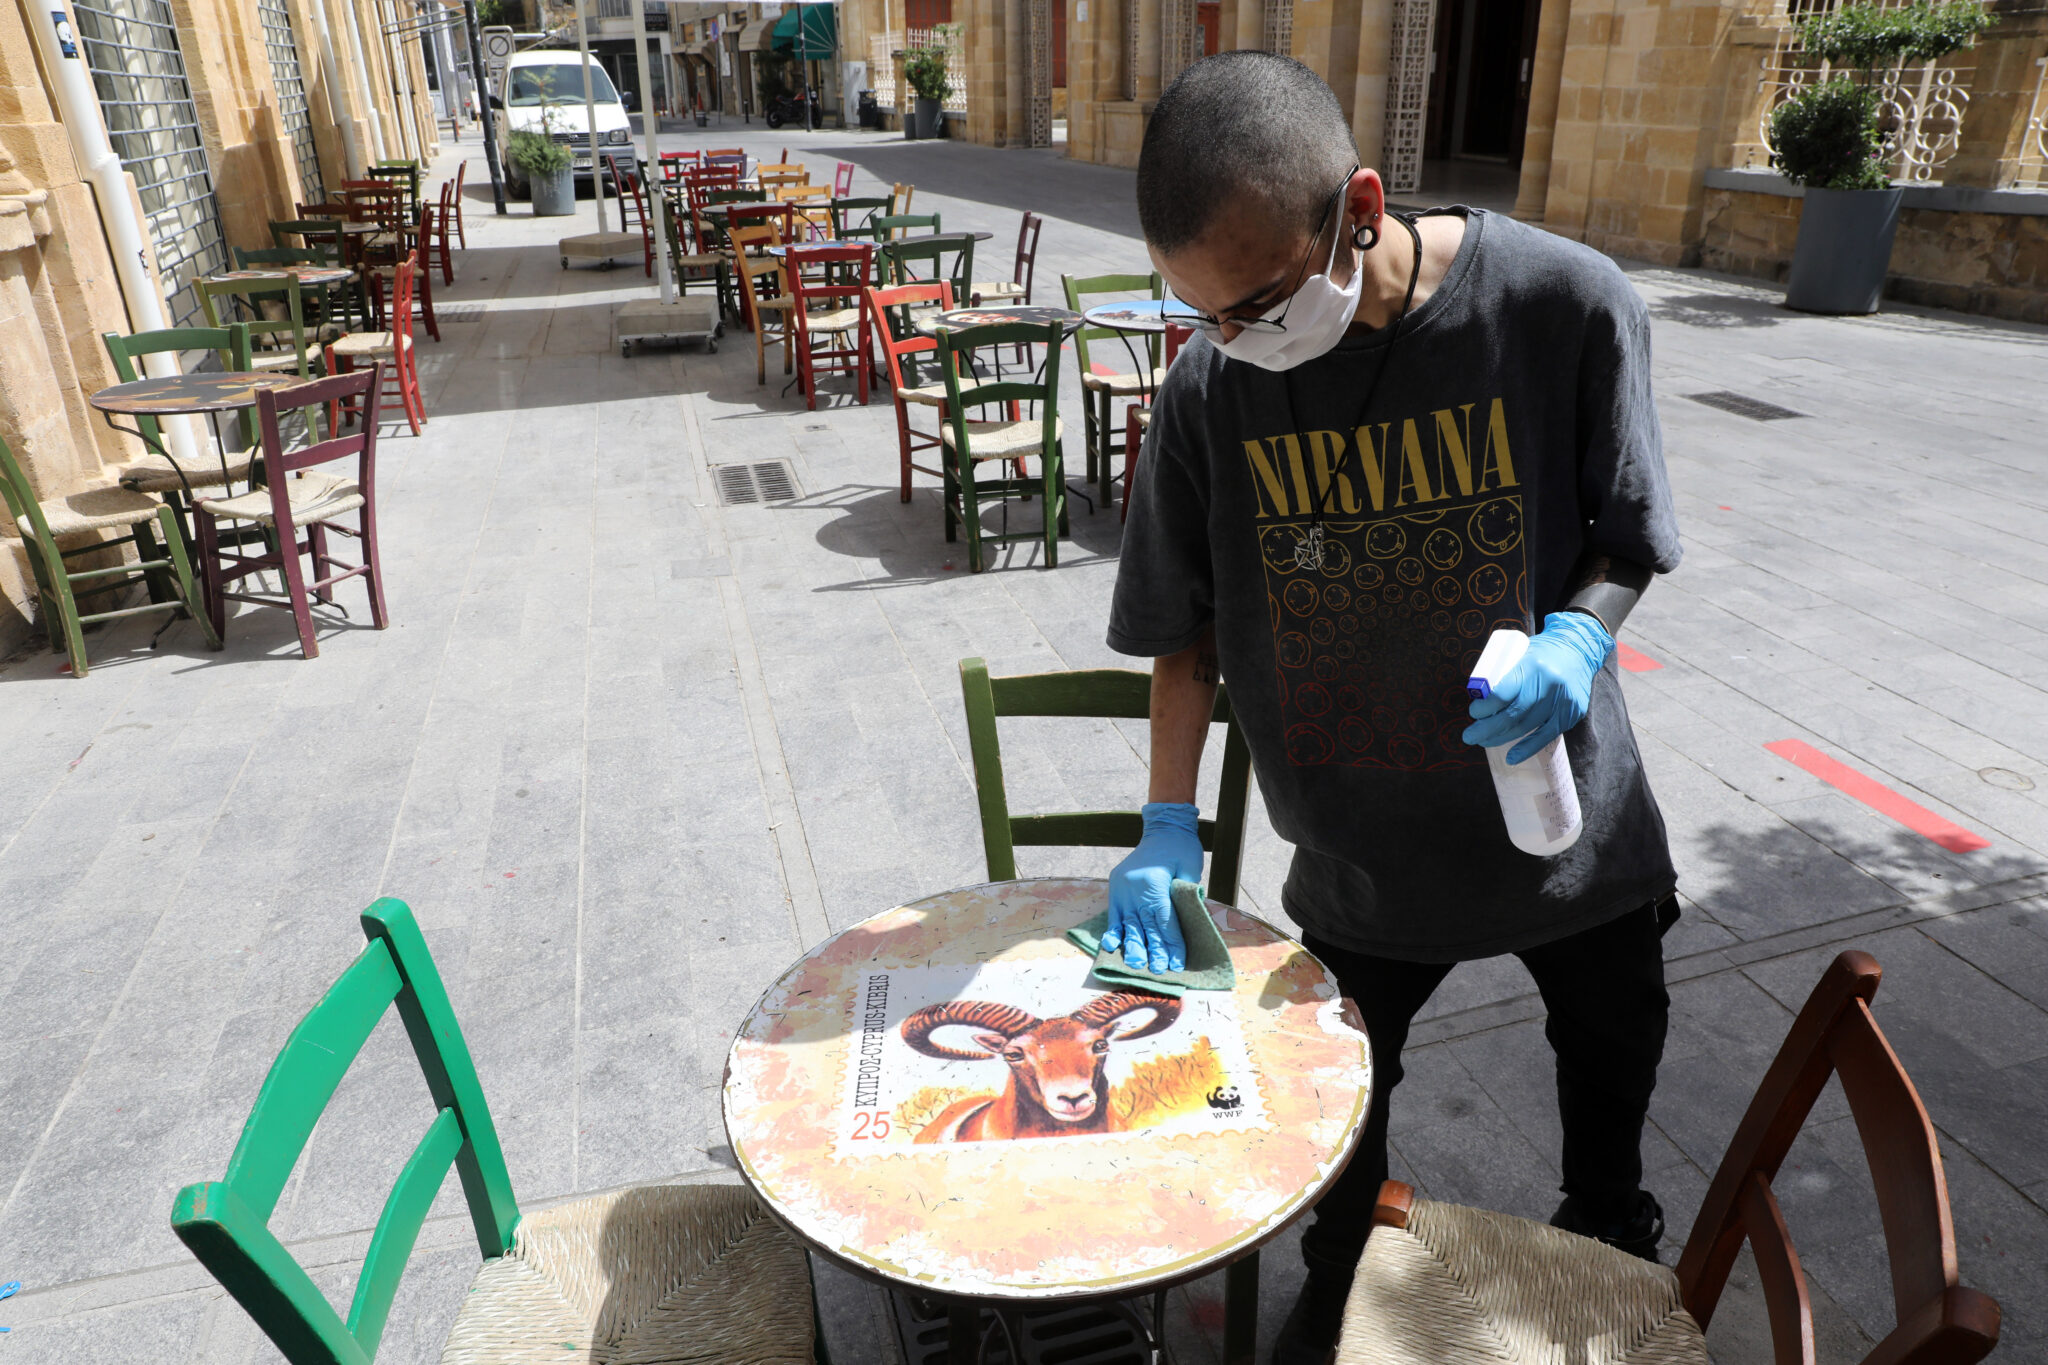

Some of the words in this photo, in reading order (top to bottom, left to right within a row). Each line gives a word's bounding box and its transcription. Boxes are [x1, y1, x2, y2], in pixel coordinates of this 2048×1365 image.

[1241, 397, 1521, 518] NIRVANA
[851, 1111, 890, 1141] 25
[1212, 1109, 1243, 1119] WWF
